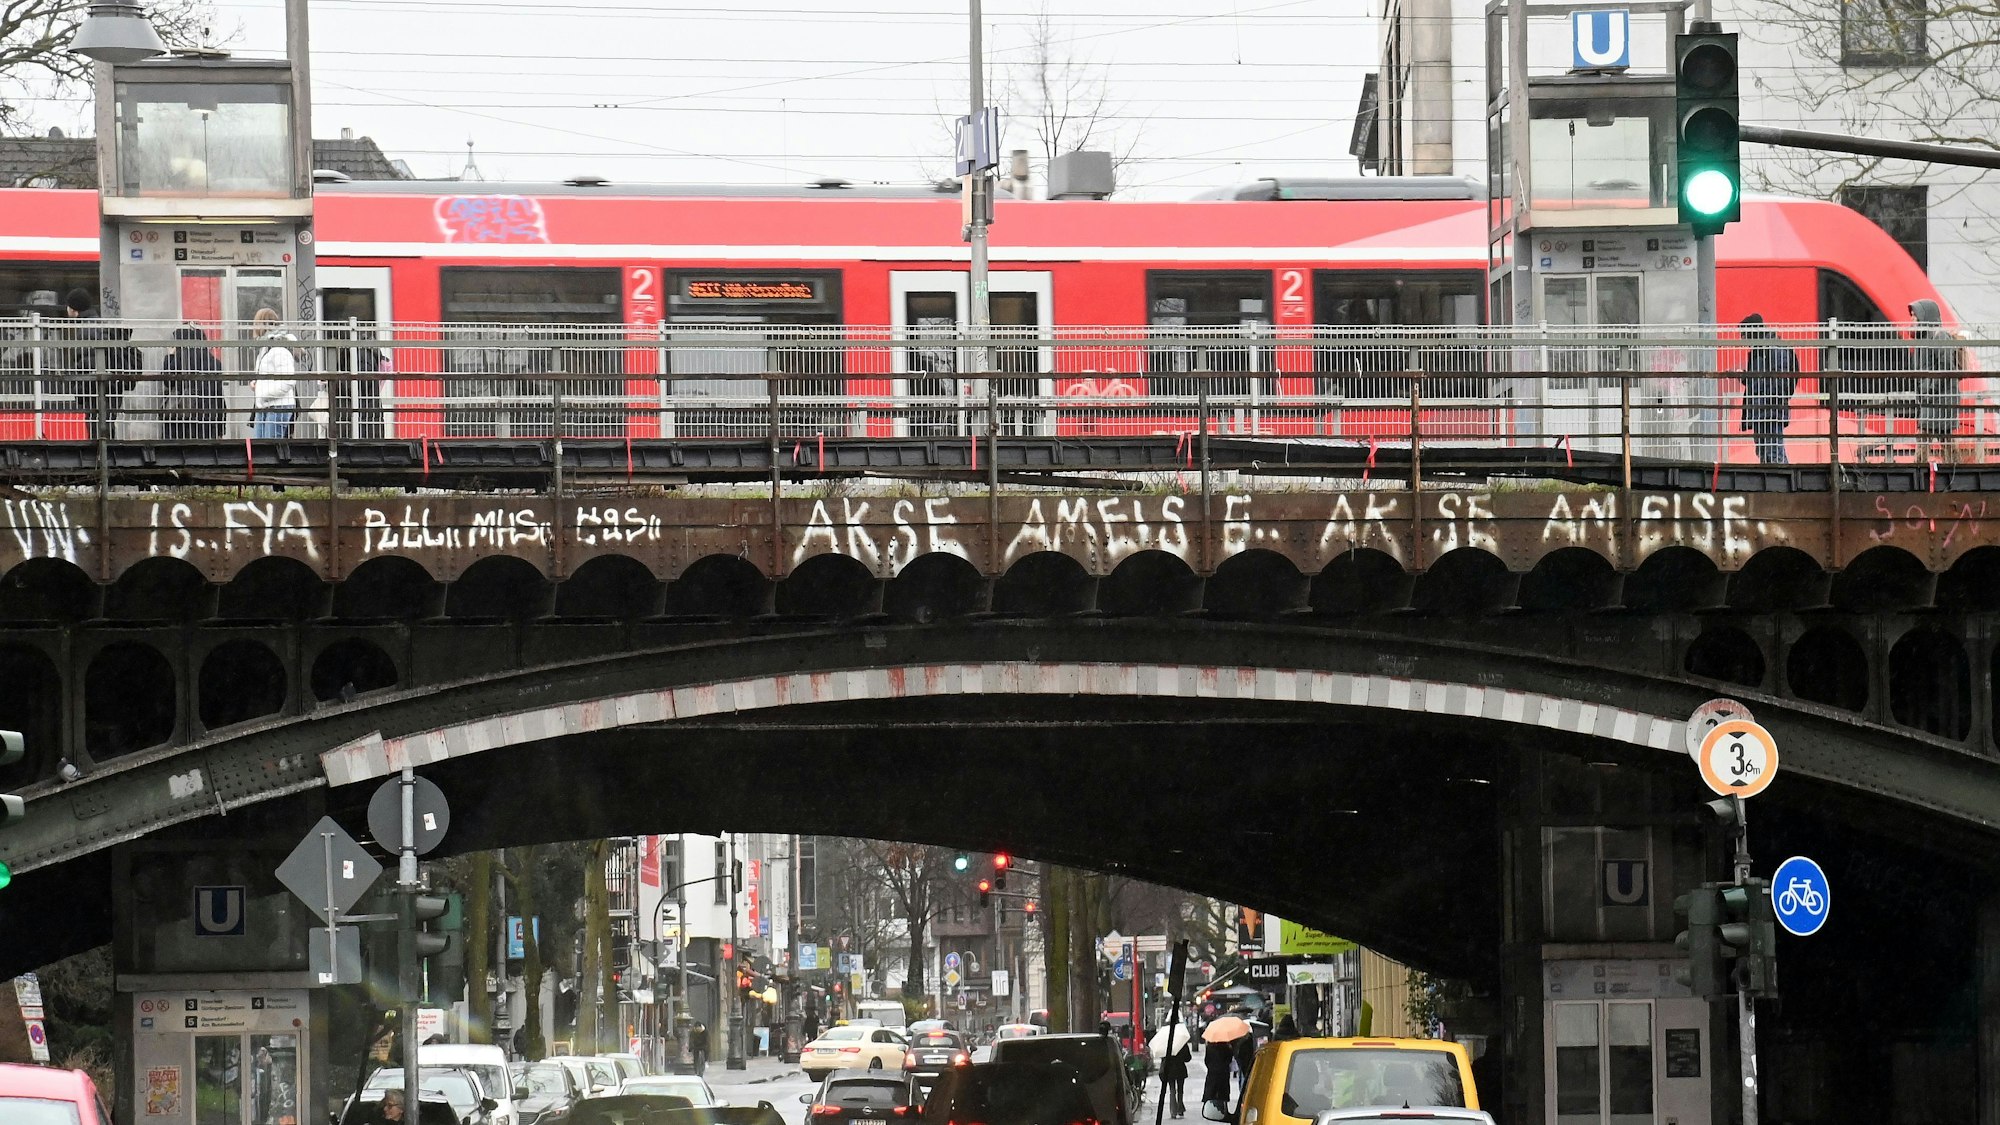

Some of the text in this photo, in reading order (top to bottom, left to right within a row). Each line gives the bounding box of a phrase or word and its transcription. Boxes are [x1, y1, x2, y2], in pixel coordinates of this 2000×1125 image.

[1577, 13, 1624, 65] U
[956, 119, 965, 163] 2
[631, 269, 654, 300] 2
[1282, 271, 1303, 301] 2
[1606, 863, 1644, 904] U
[199, 890, 241, 932] U
[1252, 964, 1280, 977] CLUB
